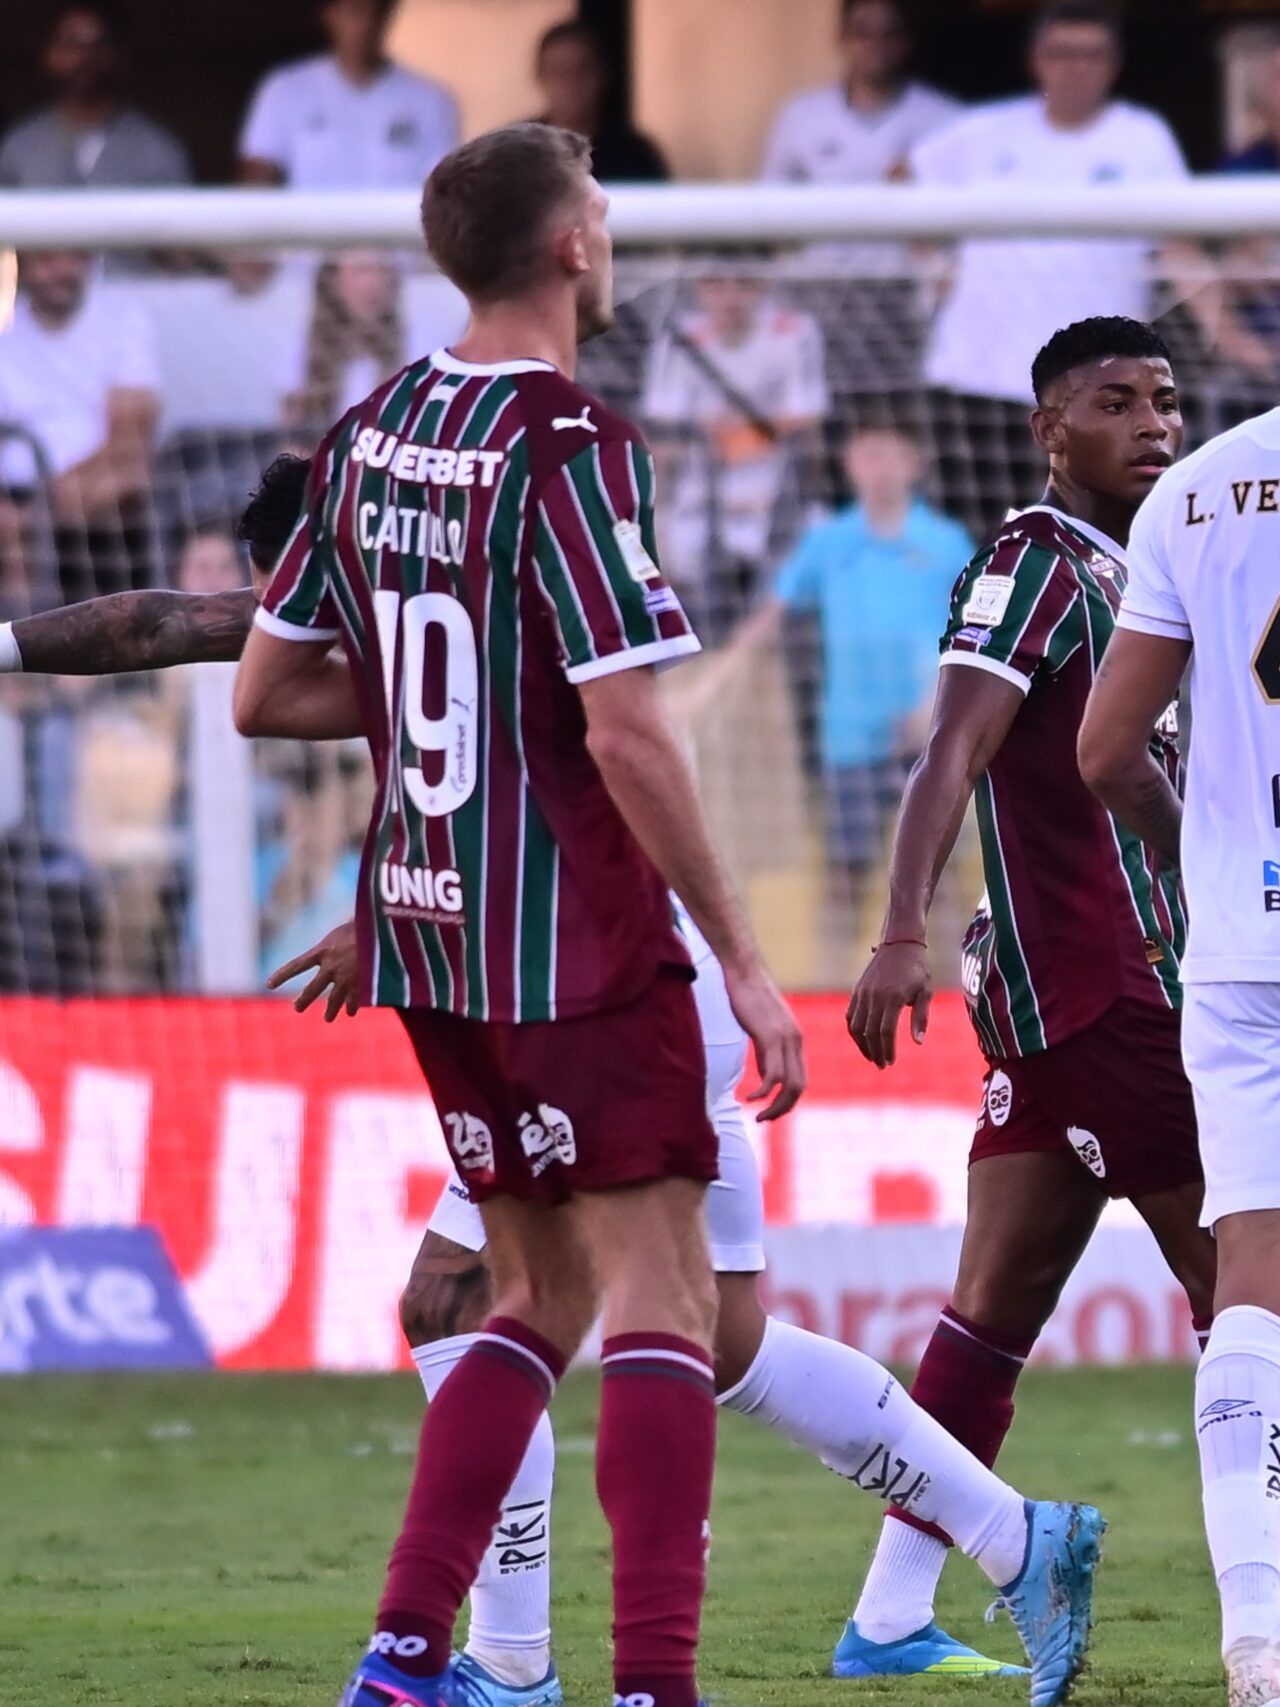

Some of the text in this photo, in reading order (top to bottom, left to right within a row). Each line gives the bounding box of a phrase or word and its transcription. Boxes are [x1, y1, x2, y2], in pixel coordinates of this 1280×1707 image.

[1186, 493, 1216, 526] L.
[373, 590, 478, 817] 19
[380, 862, 463, 912] UNIG
[500, 1566, 520, 1575] BY
